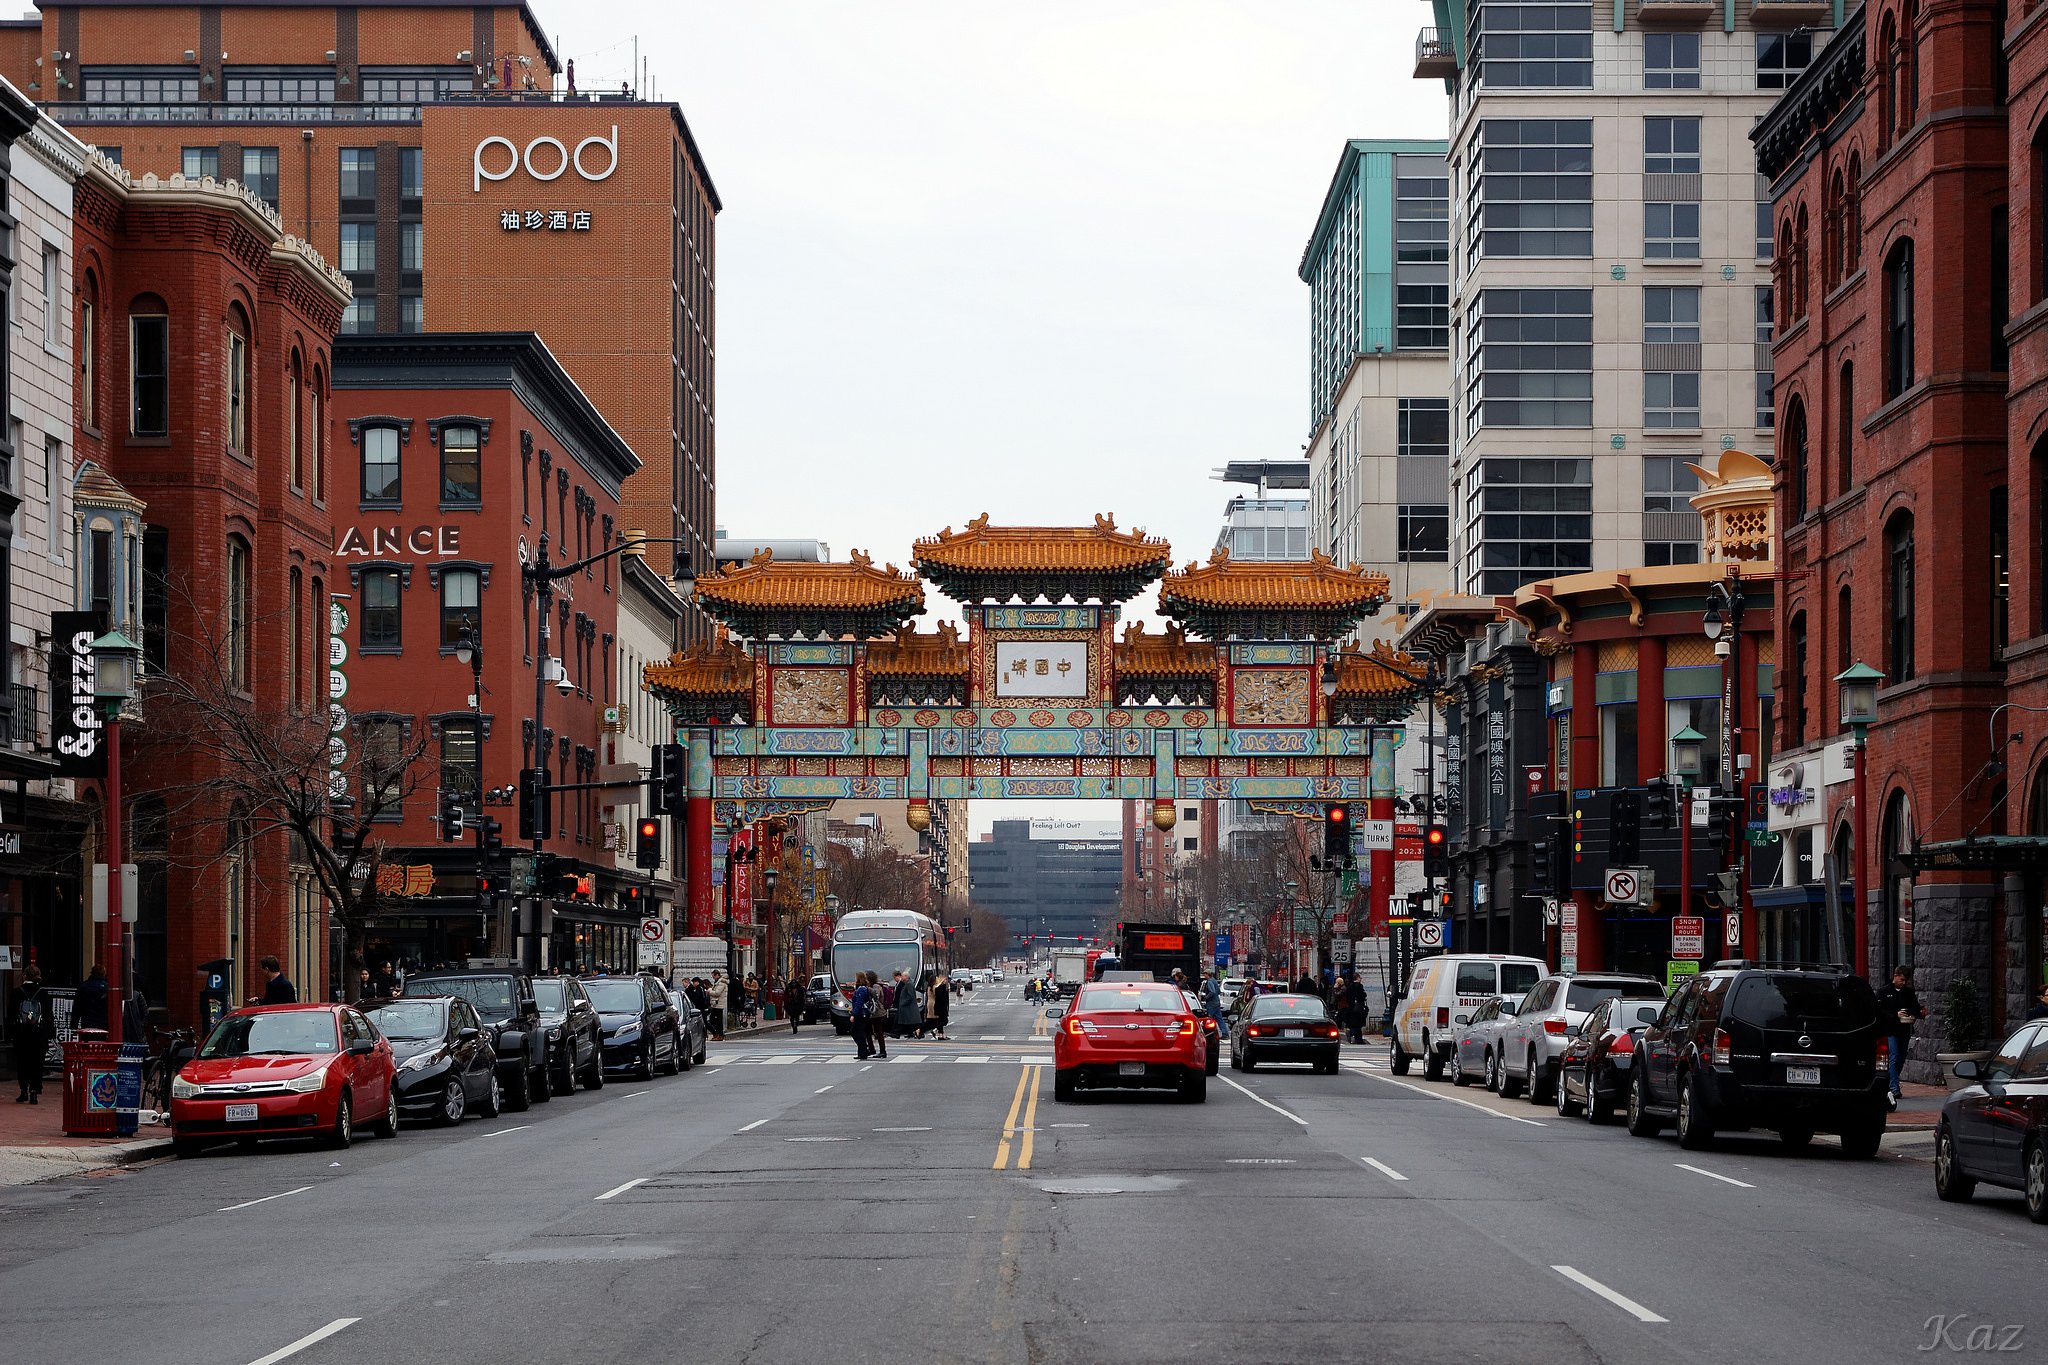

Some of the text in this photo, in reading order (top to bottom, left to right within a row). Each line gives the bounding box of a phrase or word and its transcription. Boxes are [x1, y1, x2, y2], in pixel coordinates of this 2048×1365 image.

[474, 125, 618, 192] pod
[501, 210, 591, 229] 袖珍酒店
[331, 525, 460, 556] ANCE
[58, 631, 102, 757] &pizza
[1490, 711, 1504, 795] 美國娛樂公司
[1448, 735, 1460, 798] 美國娛樂公
[1694, 806, 1707, 815] TURNS
[1032, 822, 1053, 830] Feeling
[5, 833, 20, 853] Grill
[1756, 831, 1763, 840] 7
[1065, 844, 1085, 852] Douglas
[1390, 900, 1402, 915] M
[1334, 952, 1348, 962] 25
[1788, 1071, 1818, 1080] CH 7706
[227, 1108, 236, 1118] FR
